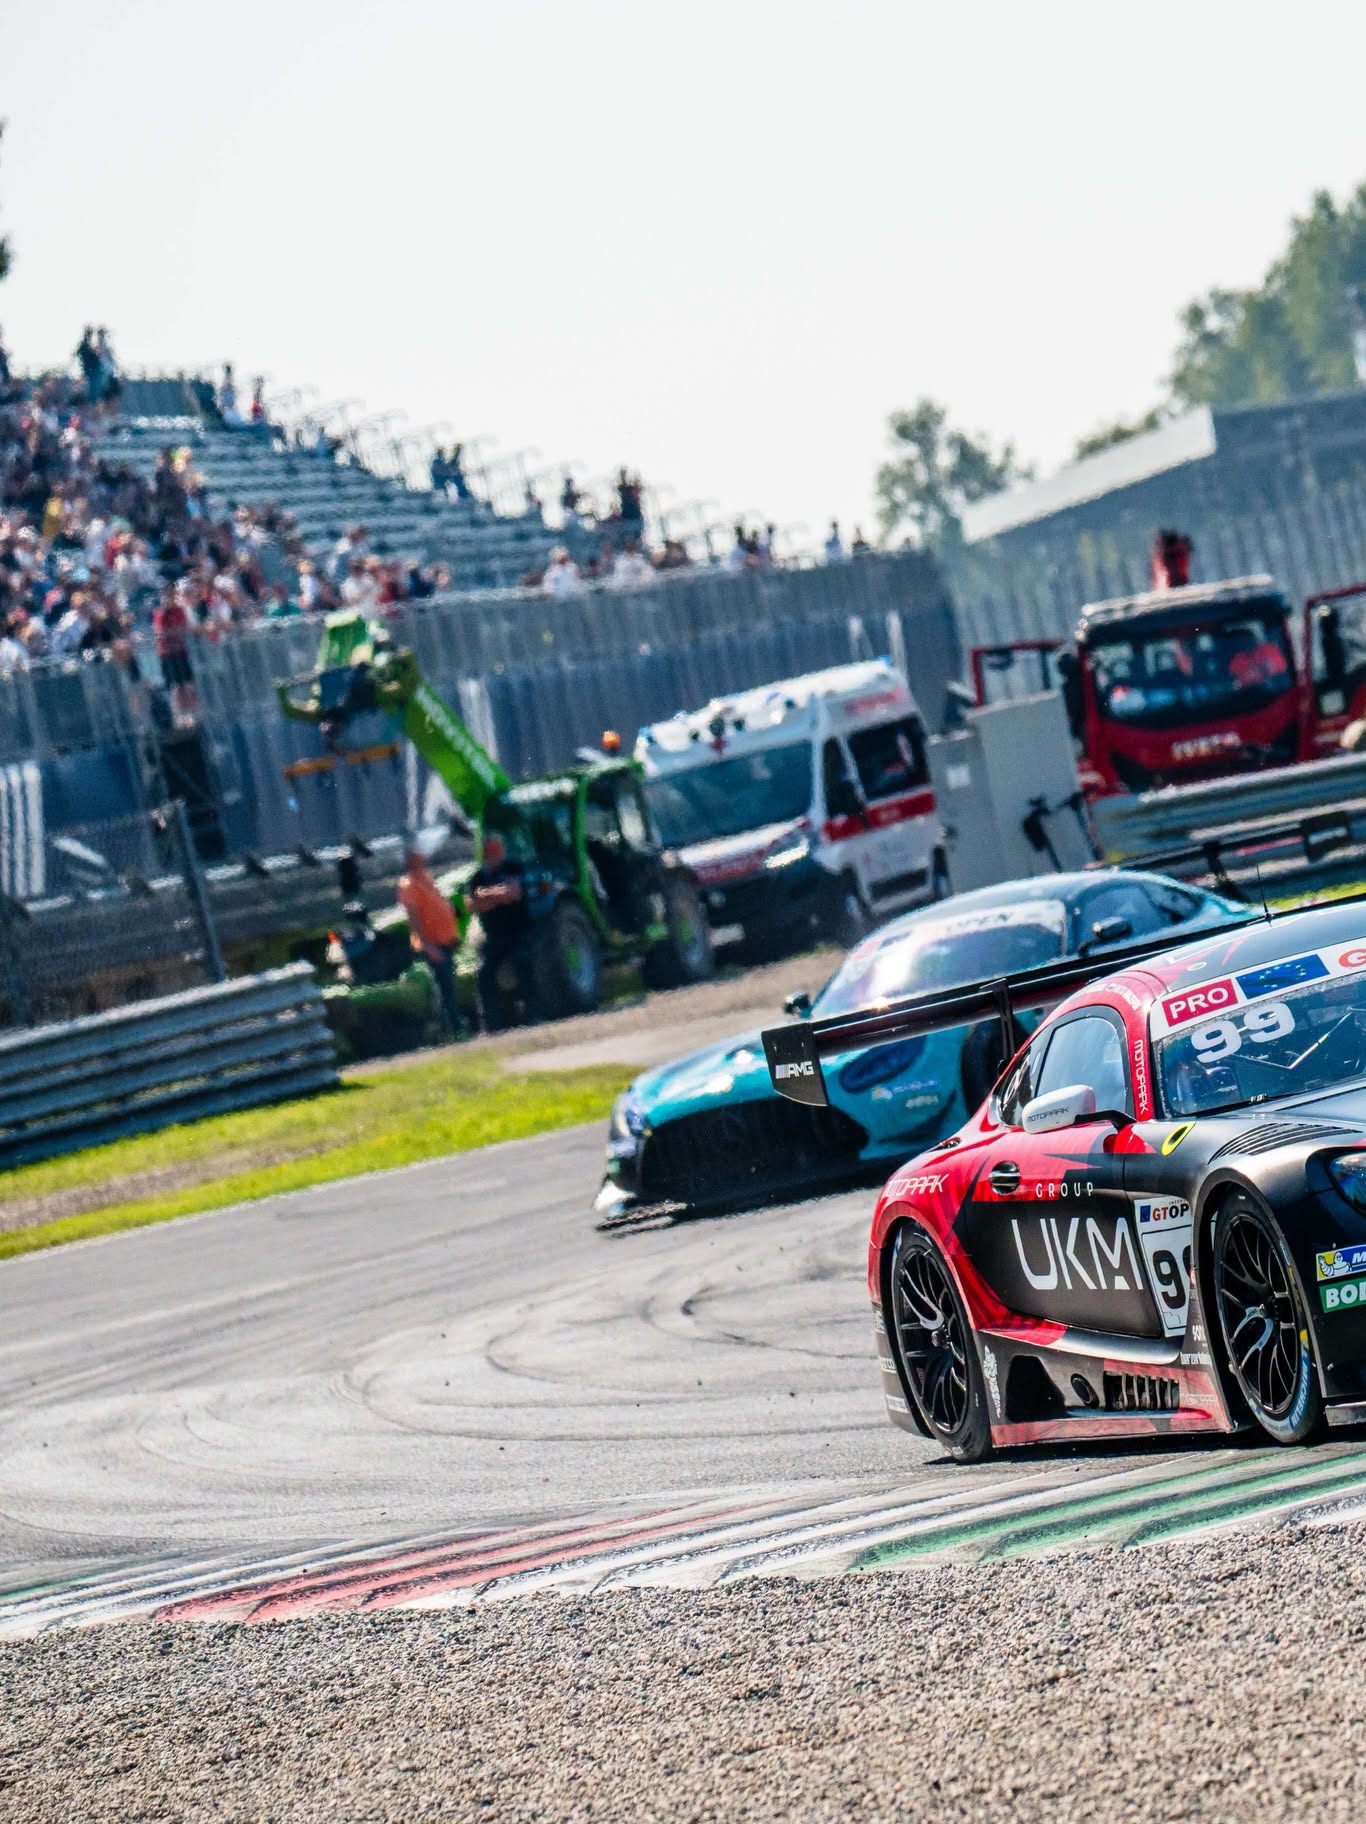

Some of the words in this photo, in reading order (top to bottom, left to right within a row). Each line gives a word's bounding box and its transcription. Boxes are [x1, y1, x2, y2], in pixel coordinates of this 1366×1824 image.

[1168, 986, 1229, 1019] PRO
[1191, 1003, 1295, 1063] 99
[788, 1061, 815, 1078] AMG
[1134, 1039, 1149, 1115] MOTOPARK
[1027, 1106, 1070, 1122] MOTOPARK
[1035, 1182, 1094, 1198] GROUP
[1152, 1203, 1190, 1221] GTOP
[1011, 1217, 1144, 1290] UKM
